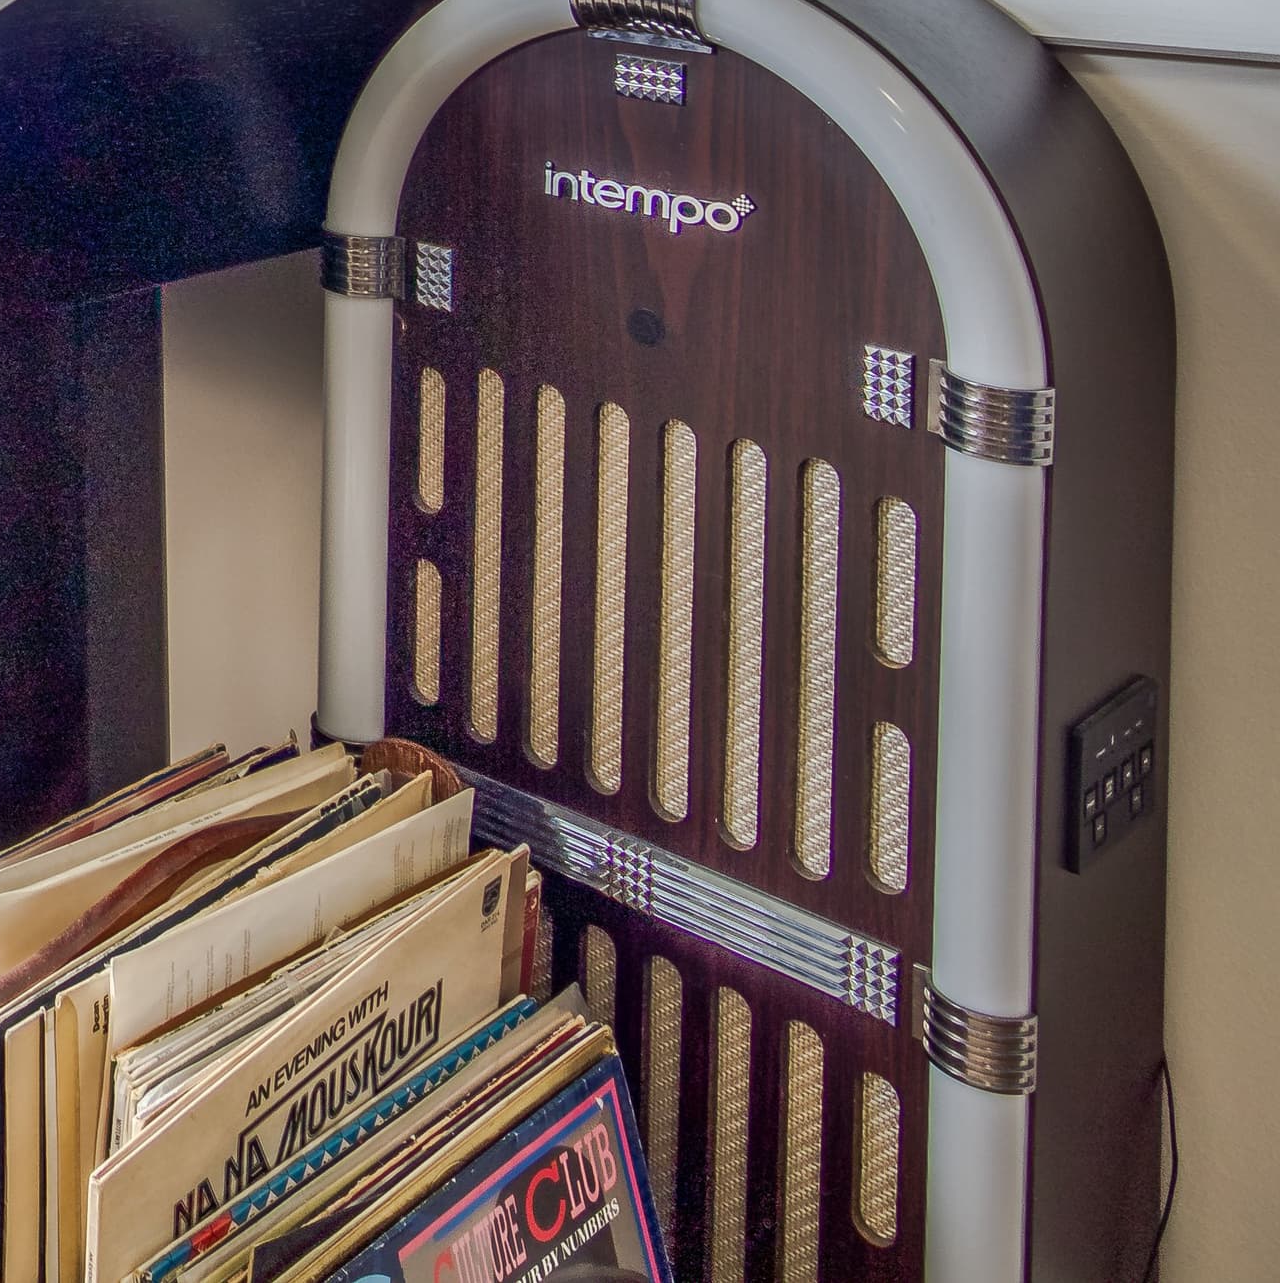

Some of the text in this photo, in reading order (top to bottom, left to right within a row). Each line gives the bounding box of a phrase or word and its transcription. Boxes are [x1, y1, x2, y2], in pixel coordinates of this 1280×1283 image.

[544, 160, 740, 234] intempo
[245, 1076, 272, 1117] AN
[273, 1017, 347, 1094] EVENING
[347, 980, 390, 1029] WITH
[525, 1122, 618, 1243] CLUB
[541, 1247, 560, 1277] BY
[559, 1197, 621, 1260] NUMBERS
